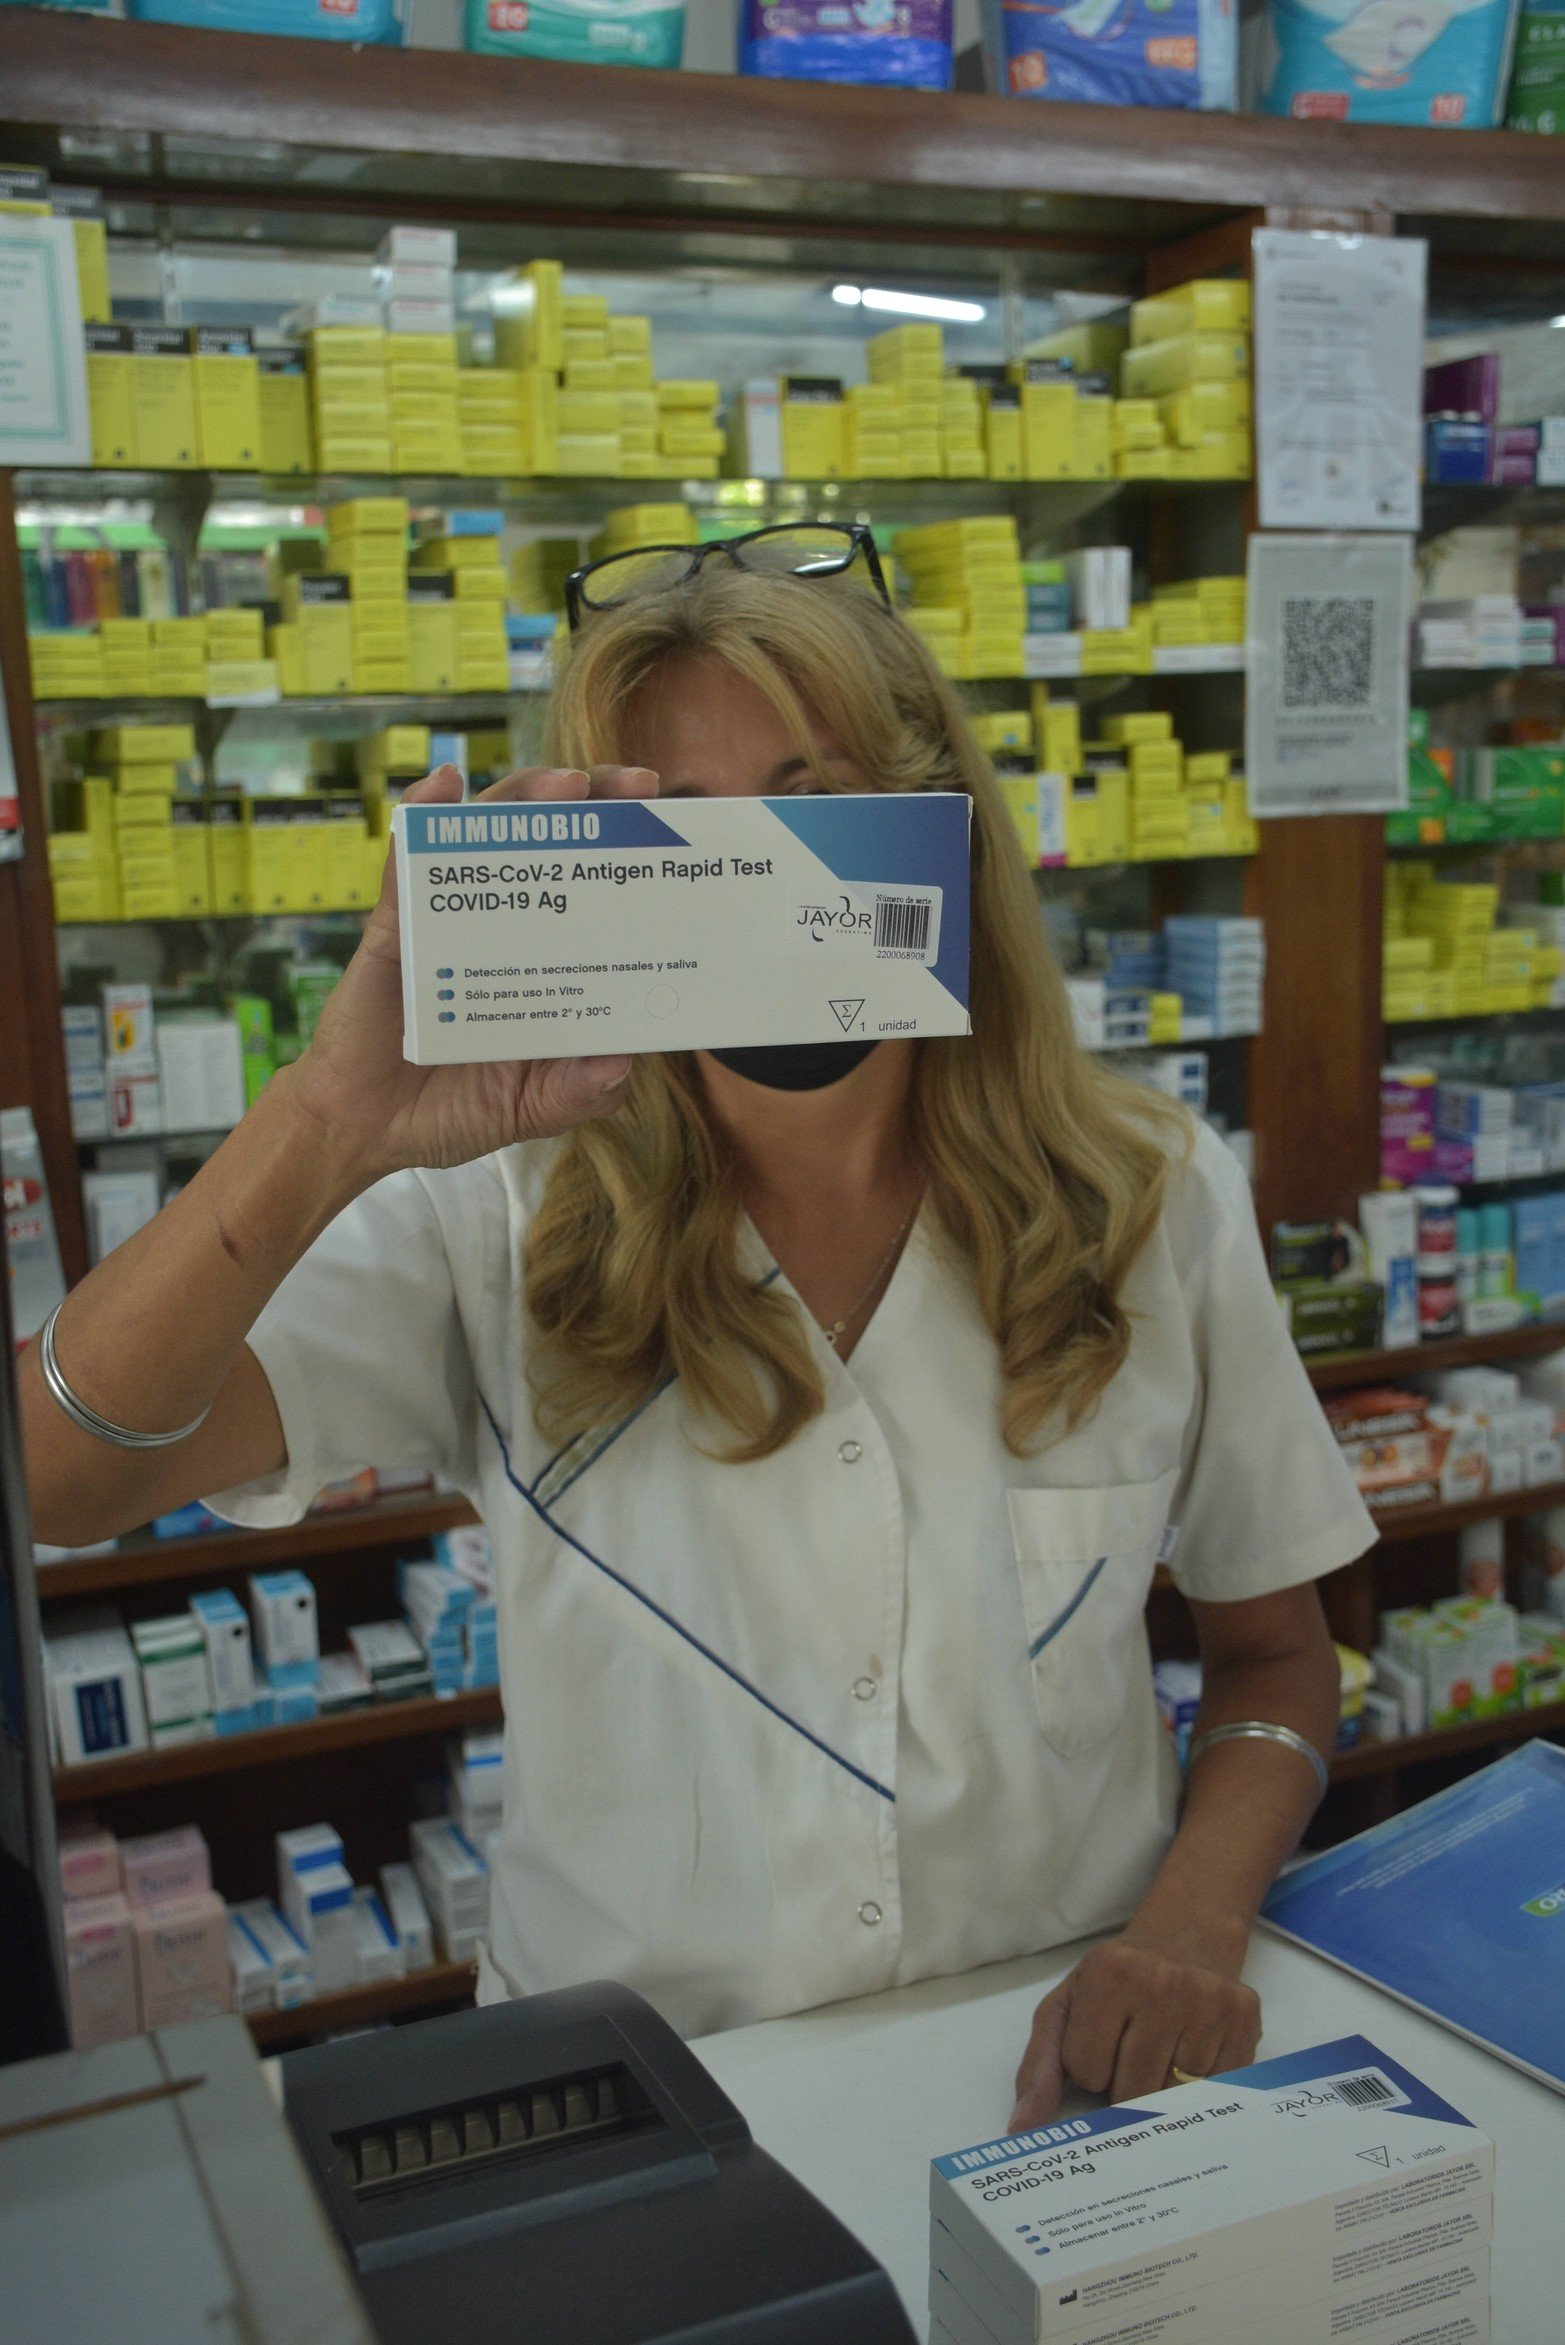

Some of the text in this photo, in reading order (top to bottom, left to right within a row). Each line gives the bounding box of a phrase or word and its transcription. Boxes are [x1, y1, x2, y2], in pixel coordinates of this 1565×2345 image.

[427, 813, 599, 844] IMMUNOBIO
[429, 858, 773, 885] SARS-CoV-2 Antigen Rapid Test
[430, 891, 566, 914] COVID-19 Ag
[876, 894, 932, 905] Número de serie
[797, 909, 872, 929] JAYOR
[876, 949, 925, 961] 2200068908
[464, 959, 698, 978] Detección en secreciones nasales y saliva
[465, 986, 584, 1001] Sólo para uso In Vitro
[466, 1011, 526, 1023] Almacenar
[530, 1009, 558, 1020] entre
[561, 1008, 573, 1018] 2°
[576, 1009, 582, 1020] y
[860, 1019, 917, 1032] 1 unidad
[1274, 2092, 1339, 2114] JAYOR
[951, 2120, 1092, 2171] IMMUNOBIO
[971, 2102, 1244, 2189] SARS-CoV-2 Antigen Rapid Test
[1396, 2145, 1446, 2165] 1 unidad
[983, 2162, 1096, 2202] COVID-19 Ag
[1038, 2163, 1228, 2227] Detección en secreciones nasales y saliva
[1048, 2226, 1070, 2237] Sólo
[1071, 2218, 1094, 2231] para
[1095, 2213, 1113, 2223] uso
[1124, 2202, 1147, 2214] Vitro
[1059, 2228, 1109, 2249] Almacenar
[1111, 2221, 1136, 2232] entre
[1148, 2214, 1156, 2222] y
